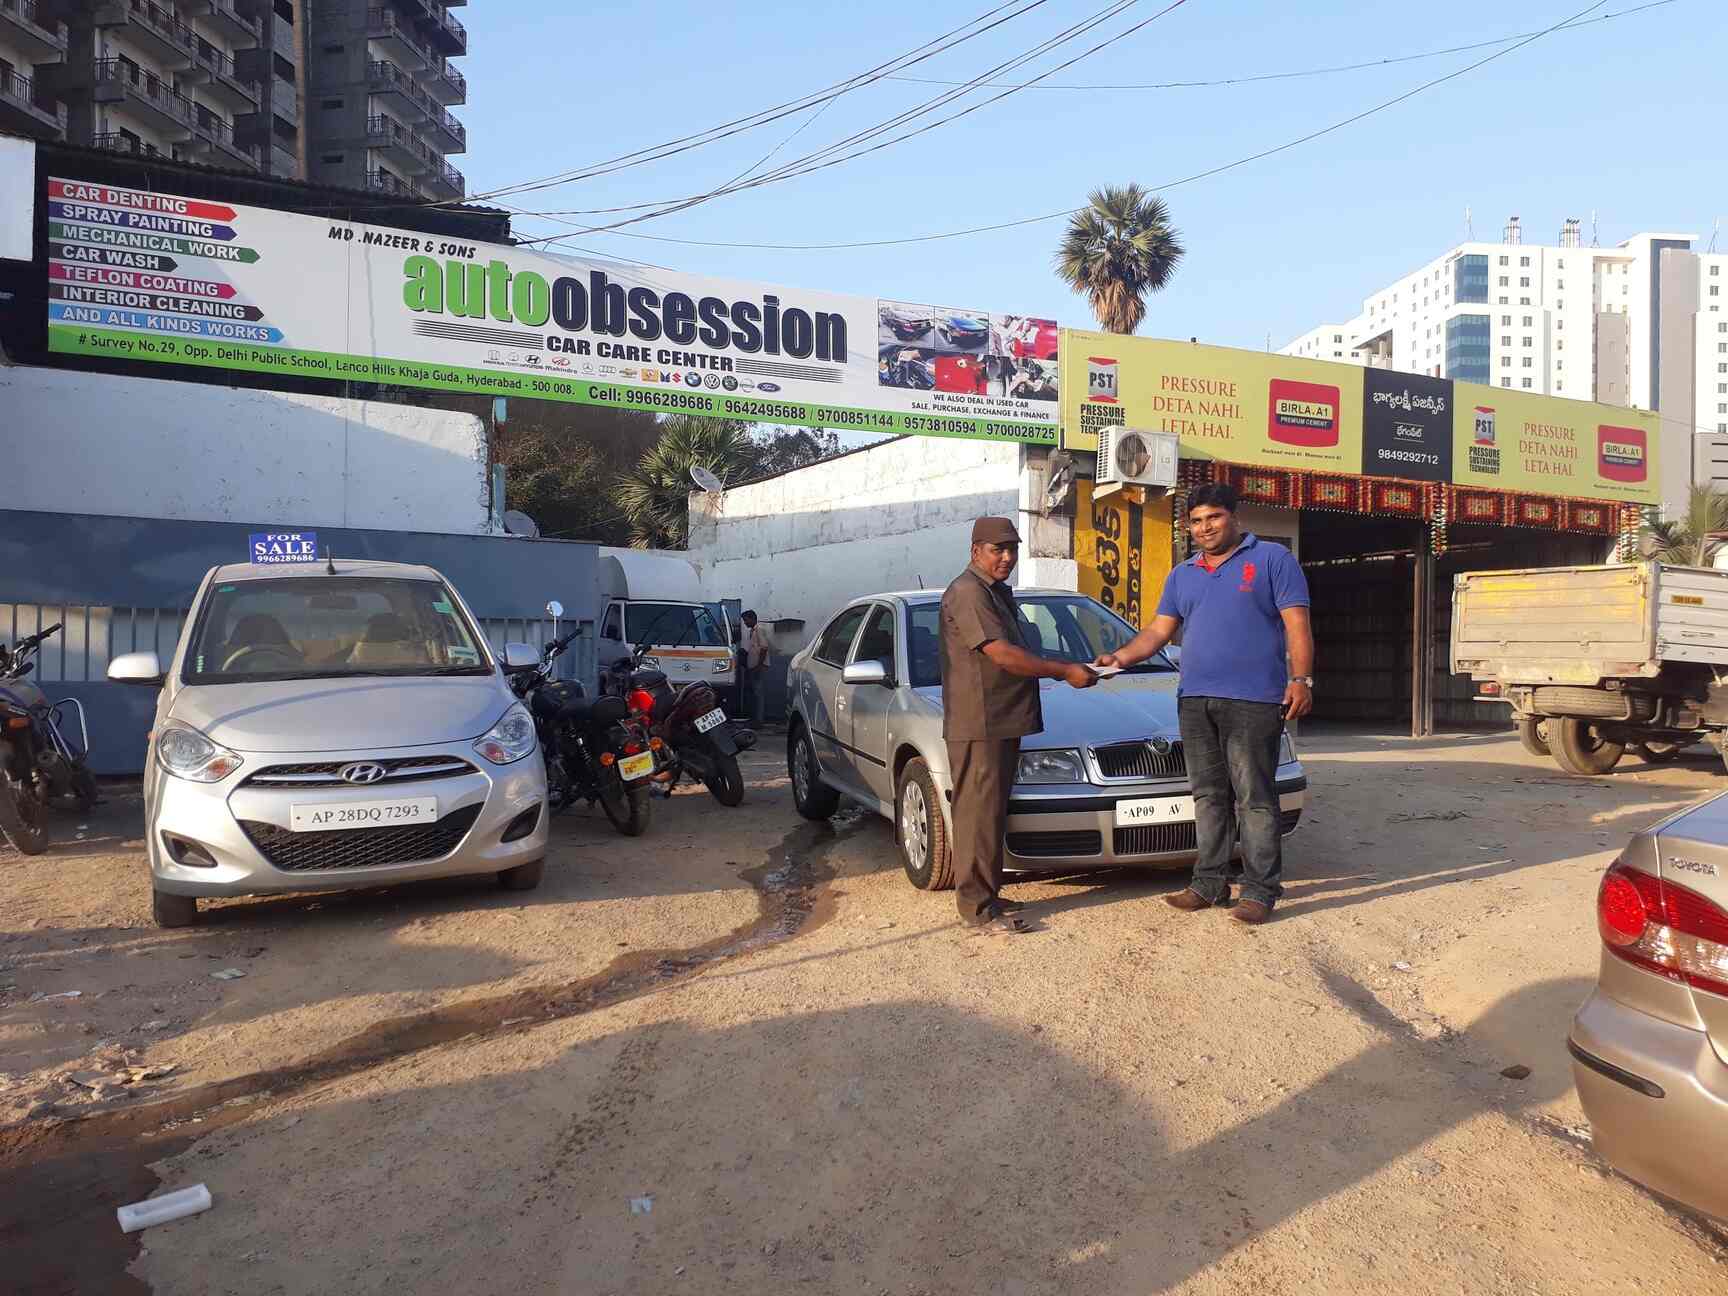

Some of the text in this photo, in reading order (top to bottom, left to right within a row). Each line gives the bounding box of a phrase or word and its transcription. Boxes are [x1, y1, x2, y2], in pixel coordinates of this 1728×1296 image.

[62, 184, 188, 213] CAR DENTING
[62, 204, 213, 237] SPRAY PAINTING
[62, 224, 240, 261] MECHANICAL WORK
[424, 240, 434, 253] &
[438, 243, 476, 259] SONS
[62, 246, 160, 270] CAR WASH
[62, 265, 219, 296] TEFLON COATING
[62, 286, 246, 319] INTERIOR CLEANING
[62, 306, 269, 341] AND ALL KINDS WORKS
[78, 333, 87, 345] #
[91, 334, 135, 353] Survey
[138, 340, 180, 356] No.29,
[184, 344, 213, 359] Opp.
[217, 348, 248, 361] Delhi
[252, 351, 287, 365] Public
[290, 355, 332, 371] School,
[336, 360, 369, 373] Lanco
[372, 363, 396, 376] Hills
[399, 366, 430, 382] Khaja
[432, 370, 463, 384] Guda,
[466, 374, 522, 390] Hyderabad
[532, 380, 551, 391] 500
[546, 336, 733, 371] CAR CARE CENTER
[1089, 372, 1114, 388] PST
[1160, 375, 1237, 398] PRESSURE
[933, 394, 1029, 409] WE ALSO DEAL IN USED CAR
[1080, 403, 1126, 418] PRESSURE
[1152, 396, 1245, 420] DETA NAHI.
[1280, 402, 1311, 416] BIRLA
[588, 386, 621, 402] Cell:
[625, 389, 713, 410] 9966289686
[725, 400, 806, 420] 9642495688
[816, 407, 894, 427] 9700851144
[904, 416, 977, 434] 9573810594
[986, 423, 1055, 439] 9700028725
[973, 407, 1012, 417] EXCHANGE
[1020, 411, 1050, 420] FINANCE
[1080, 415, 1126, 427] SUSTAINING
[1280, 416, 1329, 428] PREMIUM CEMENT
[1161, 418, 1199, 438] LETA
[1475, 419, 1493, 433] PST
[1524, 422, 1576, 441] PRESSURE
[1377, 448, 1440, 465] 9849292712
[1468, 446, 1500, 459] PRESSURE
[1519, 440, 1548, 457] DETA
[1524, 459, 1551, 474] LETA
[255, 541, 315, 555] SALE
[256, 554, 315, 563] 9966289686
[311, 804, 420, 824] AP 28DQ 7293
[1127, 803, 1182, 818] AP09 AV
[1668, 857, 1720, 876] TOYOTA
